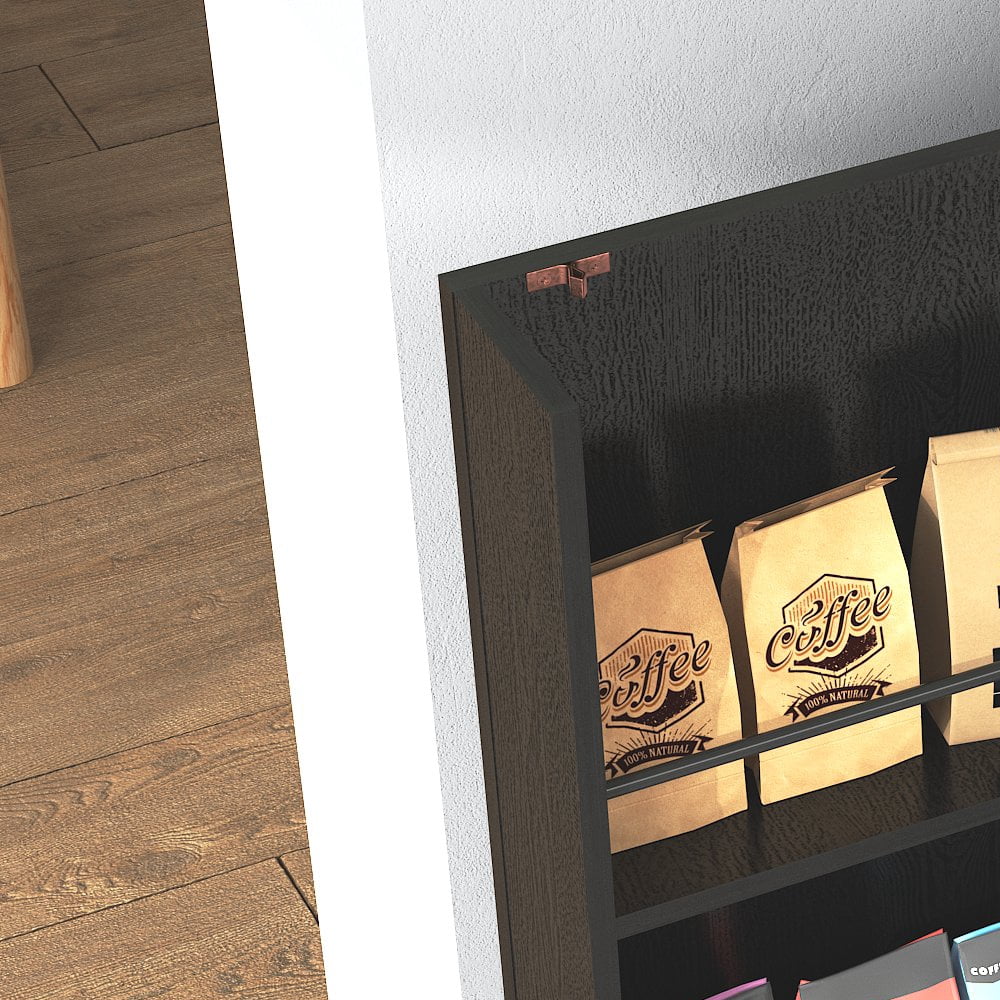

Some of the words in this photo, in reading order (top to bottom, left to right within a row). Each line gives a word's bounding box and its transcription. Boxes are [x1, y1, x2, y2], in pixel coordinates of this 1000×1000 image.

[766, 585, 891, 671] Coffee
[804, 694, 829, 711] 100%
[829, 688, 869, 701] NATURAL
[623, 750, 648, 767] 100%
[649, 744, 690, 757] NATURAL
